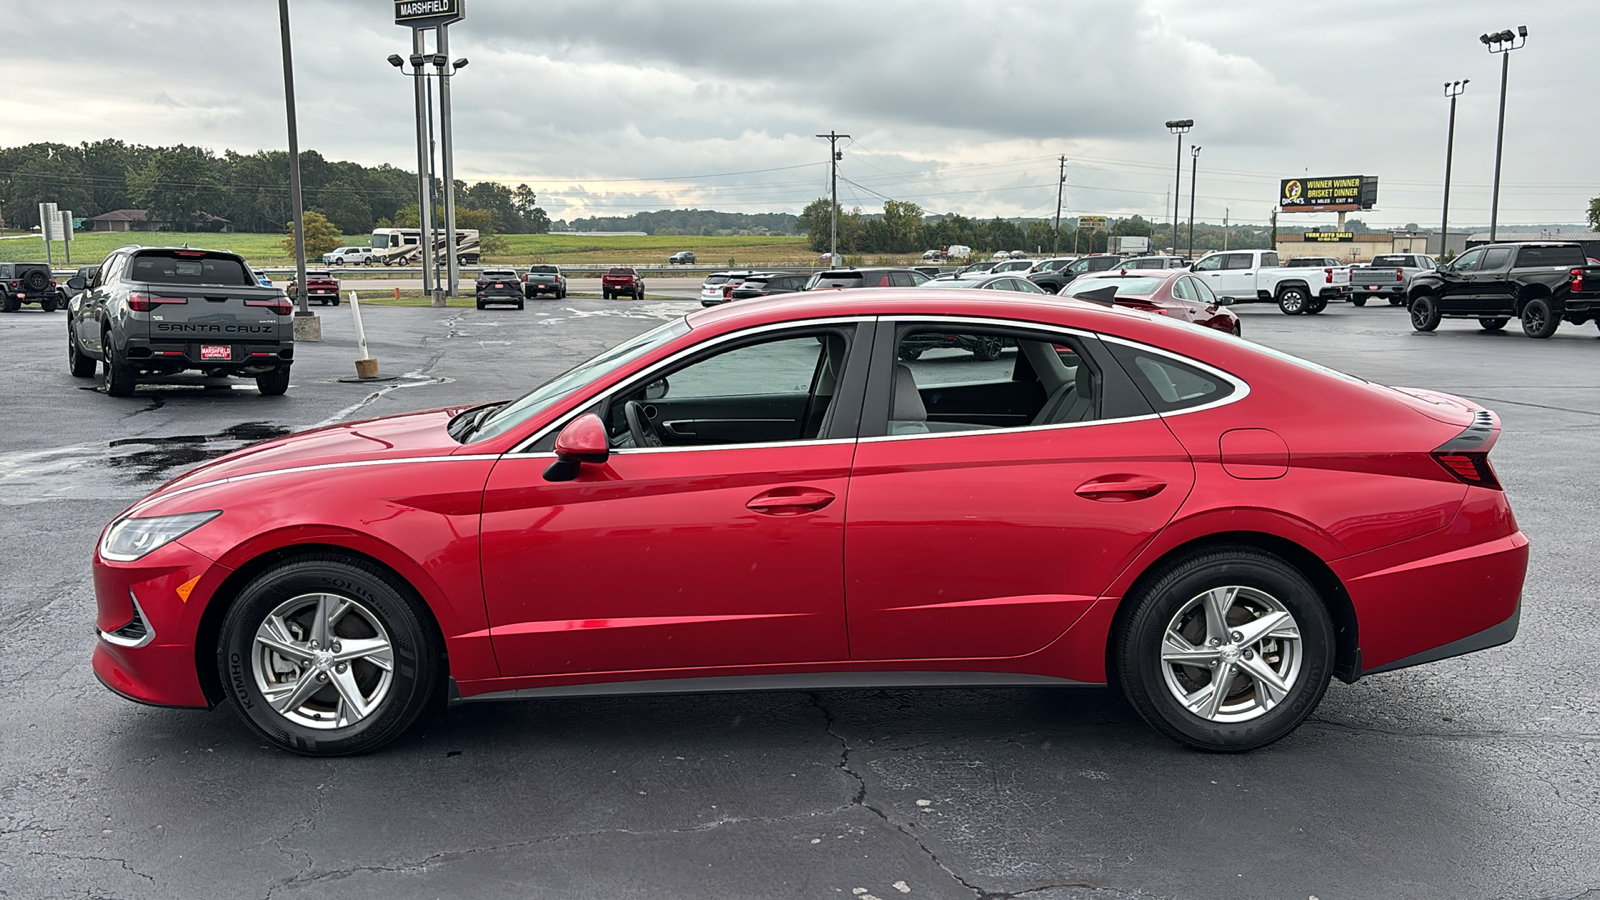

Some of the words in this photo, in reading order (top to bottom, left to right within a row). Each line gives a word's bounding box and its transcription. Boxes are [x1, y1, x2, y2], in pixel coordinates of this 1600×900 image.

[400, 0, 449, 16] MARSHFIELD
[1307, 181, 1332, 189] WINNER
[1333, 179, 1359, 187] WINNER
[1307, 189, 1333, 198] BRISKET
[1334, 188, 1358, 196] DINNER
[158, 323, 221, 333] SANTA
[225, 325, 273, 333] CRUZ
[321, 577, 378, 603] SOLUS
[231, 652, 255, 710] KUMHO
